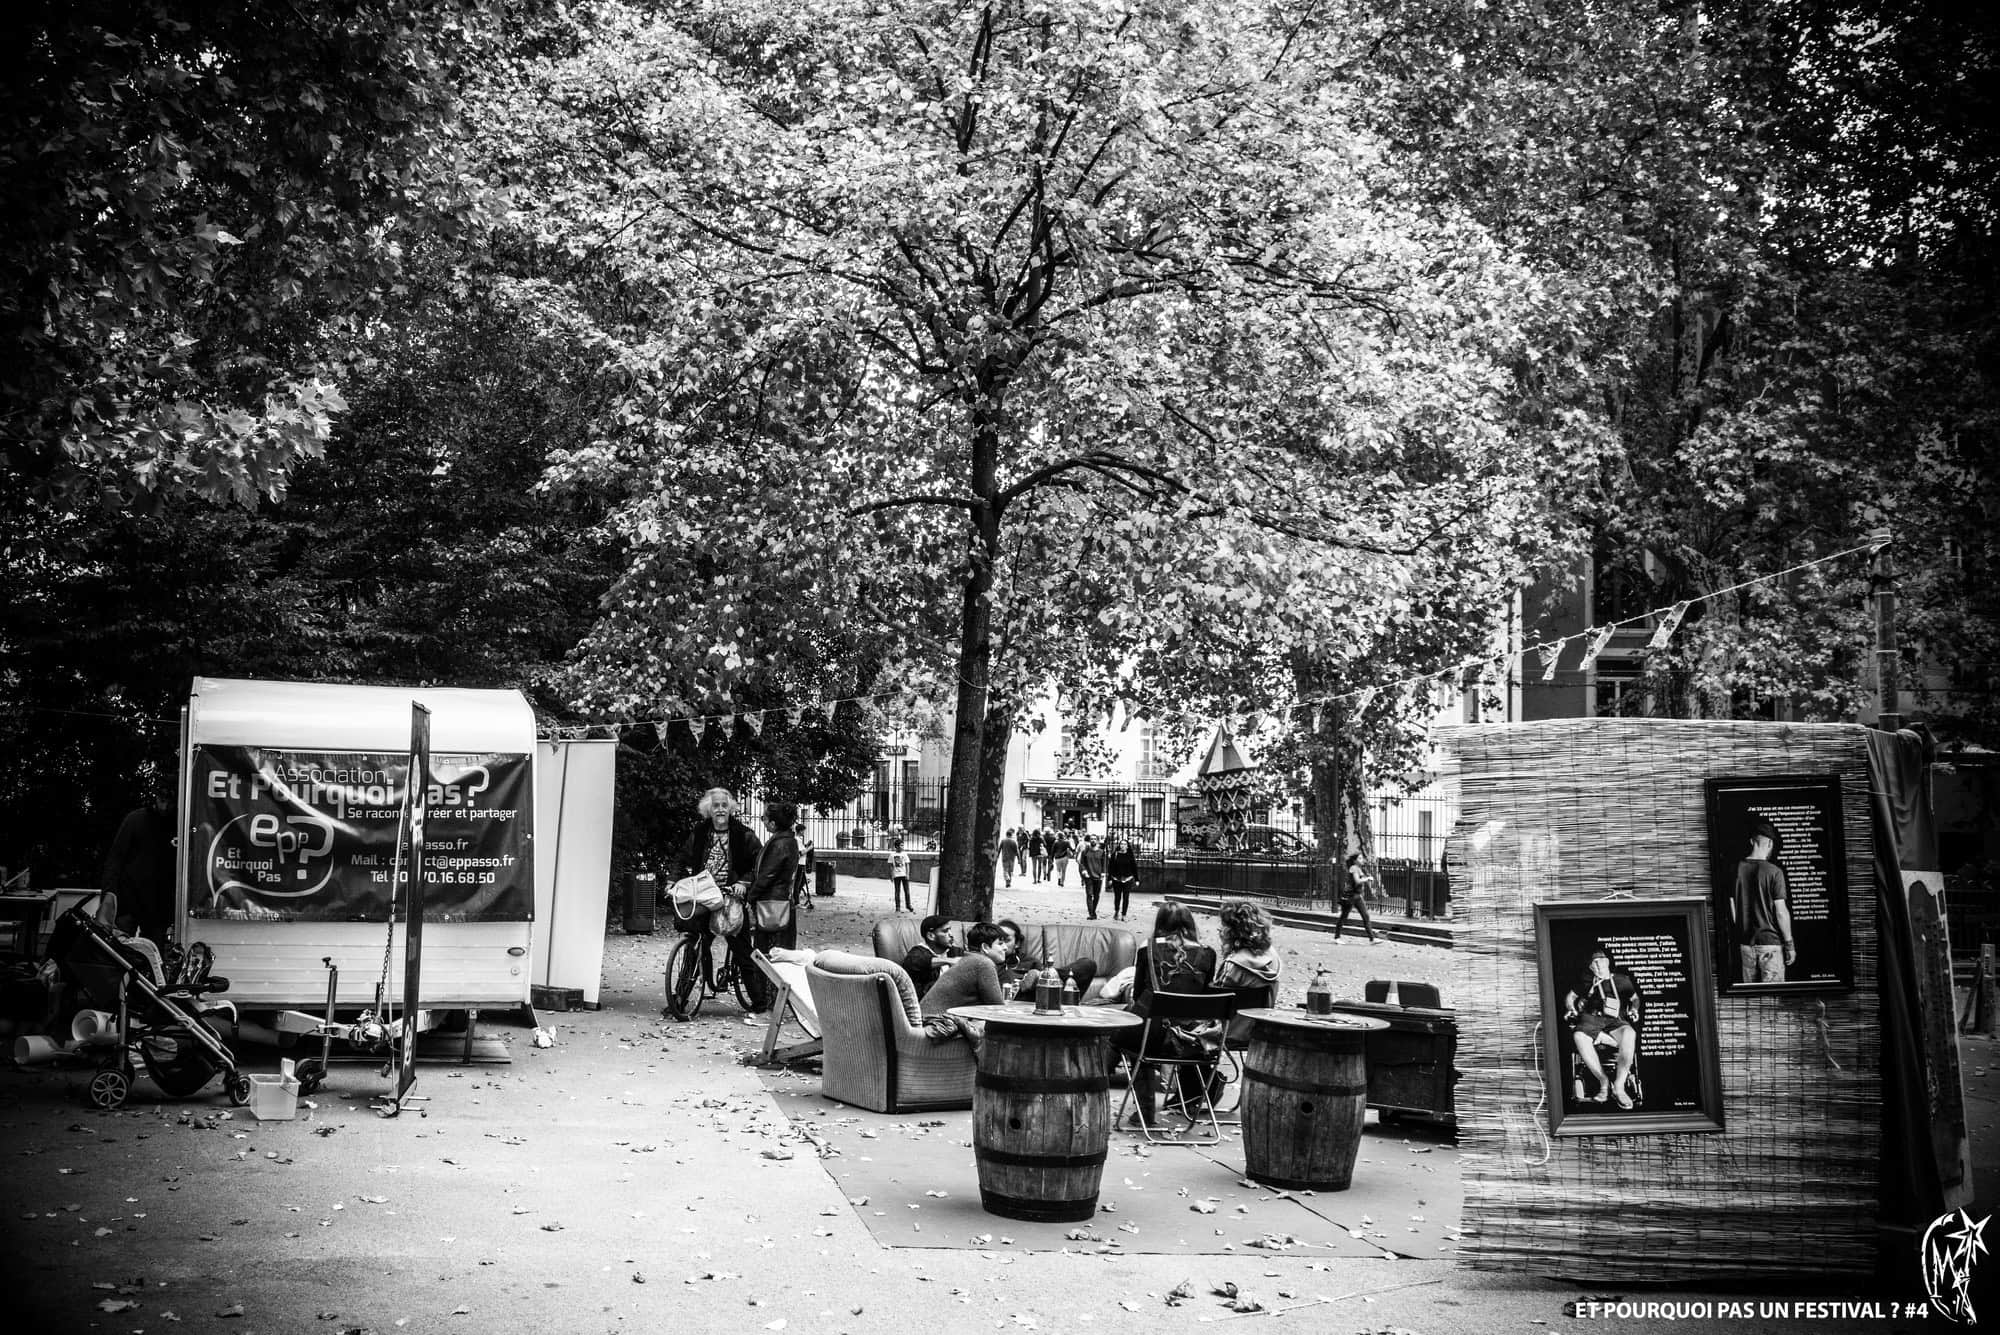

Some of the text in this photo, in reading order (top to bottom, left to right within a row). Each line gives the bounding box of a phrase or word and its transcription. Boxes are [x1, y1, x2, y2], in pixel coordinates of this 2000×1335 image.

[275, 764, 386, 784] Association
[208, 765, 490, 819] Et Pourquoi as ?
[348, 807, 362, 819] Se
[425, 807, 453, 819] réer
[455, 808, 467, 819] et
[470, 808, 518, 822] partager
[402, 838, 469, 850] easso.fr
[228, 847, 241, 859] Et
[351, 854, 378, 865] Mail
[216, 857, 273, 874] Pourquoi
[258, 871, 281, 883] Pas
[370, 870, 389, 883] Tél
